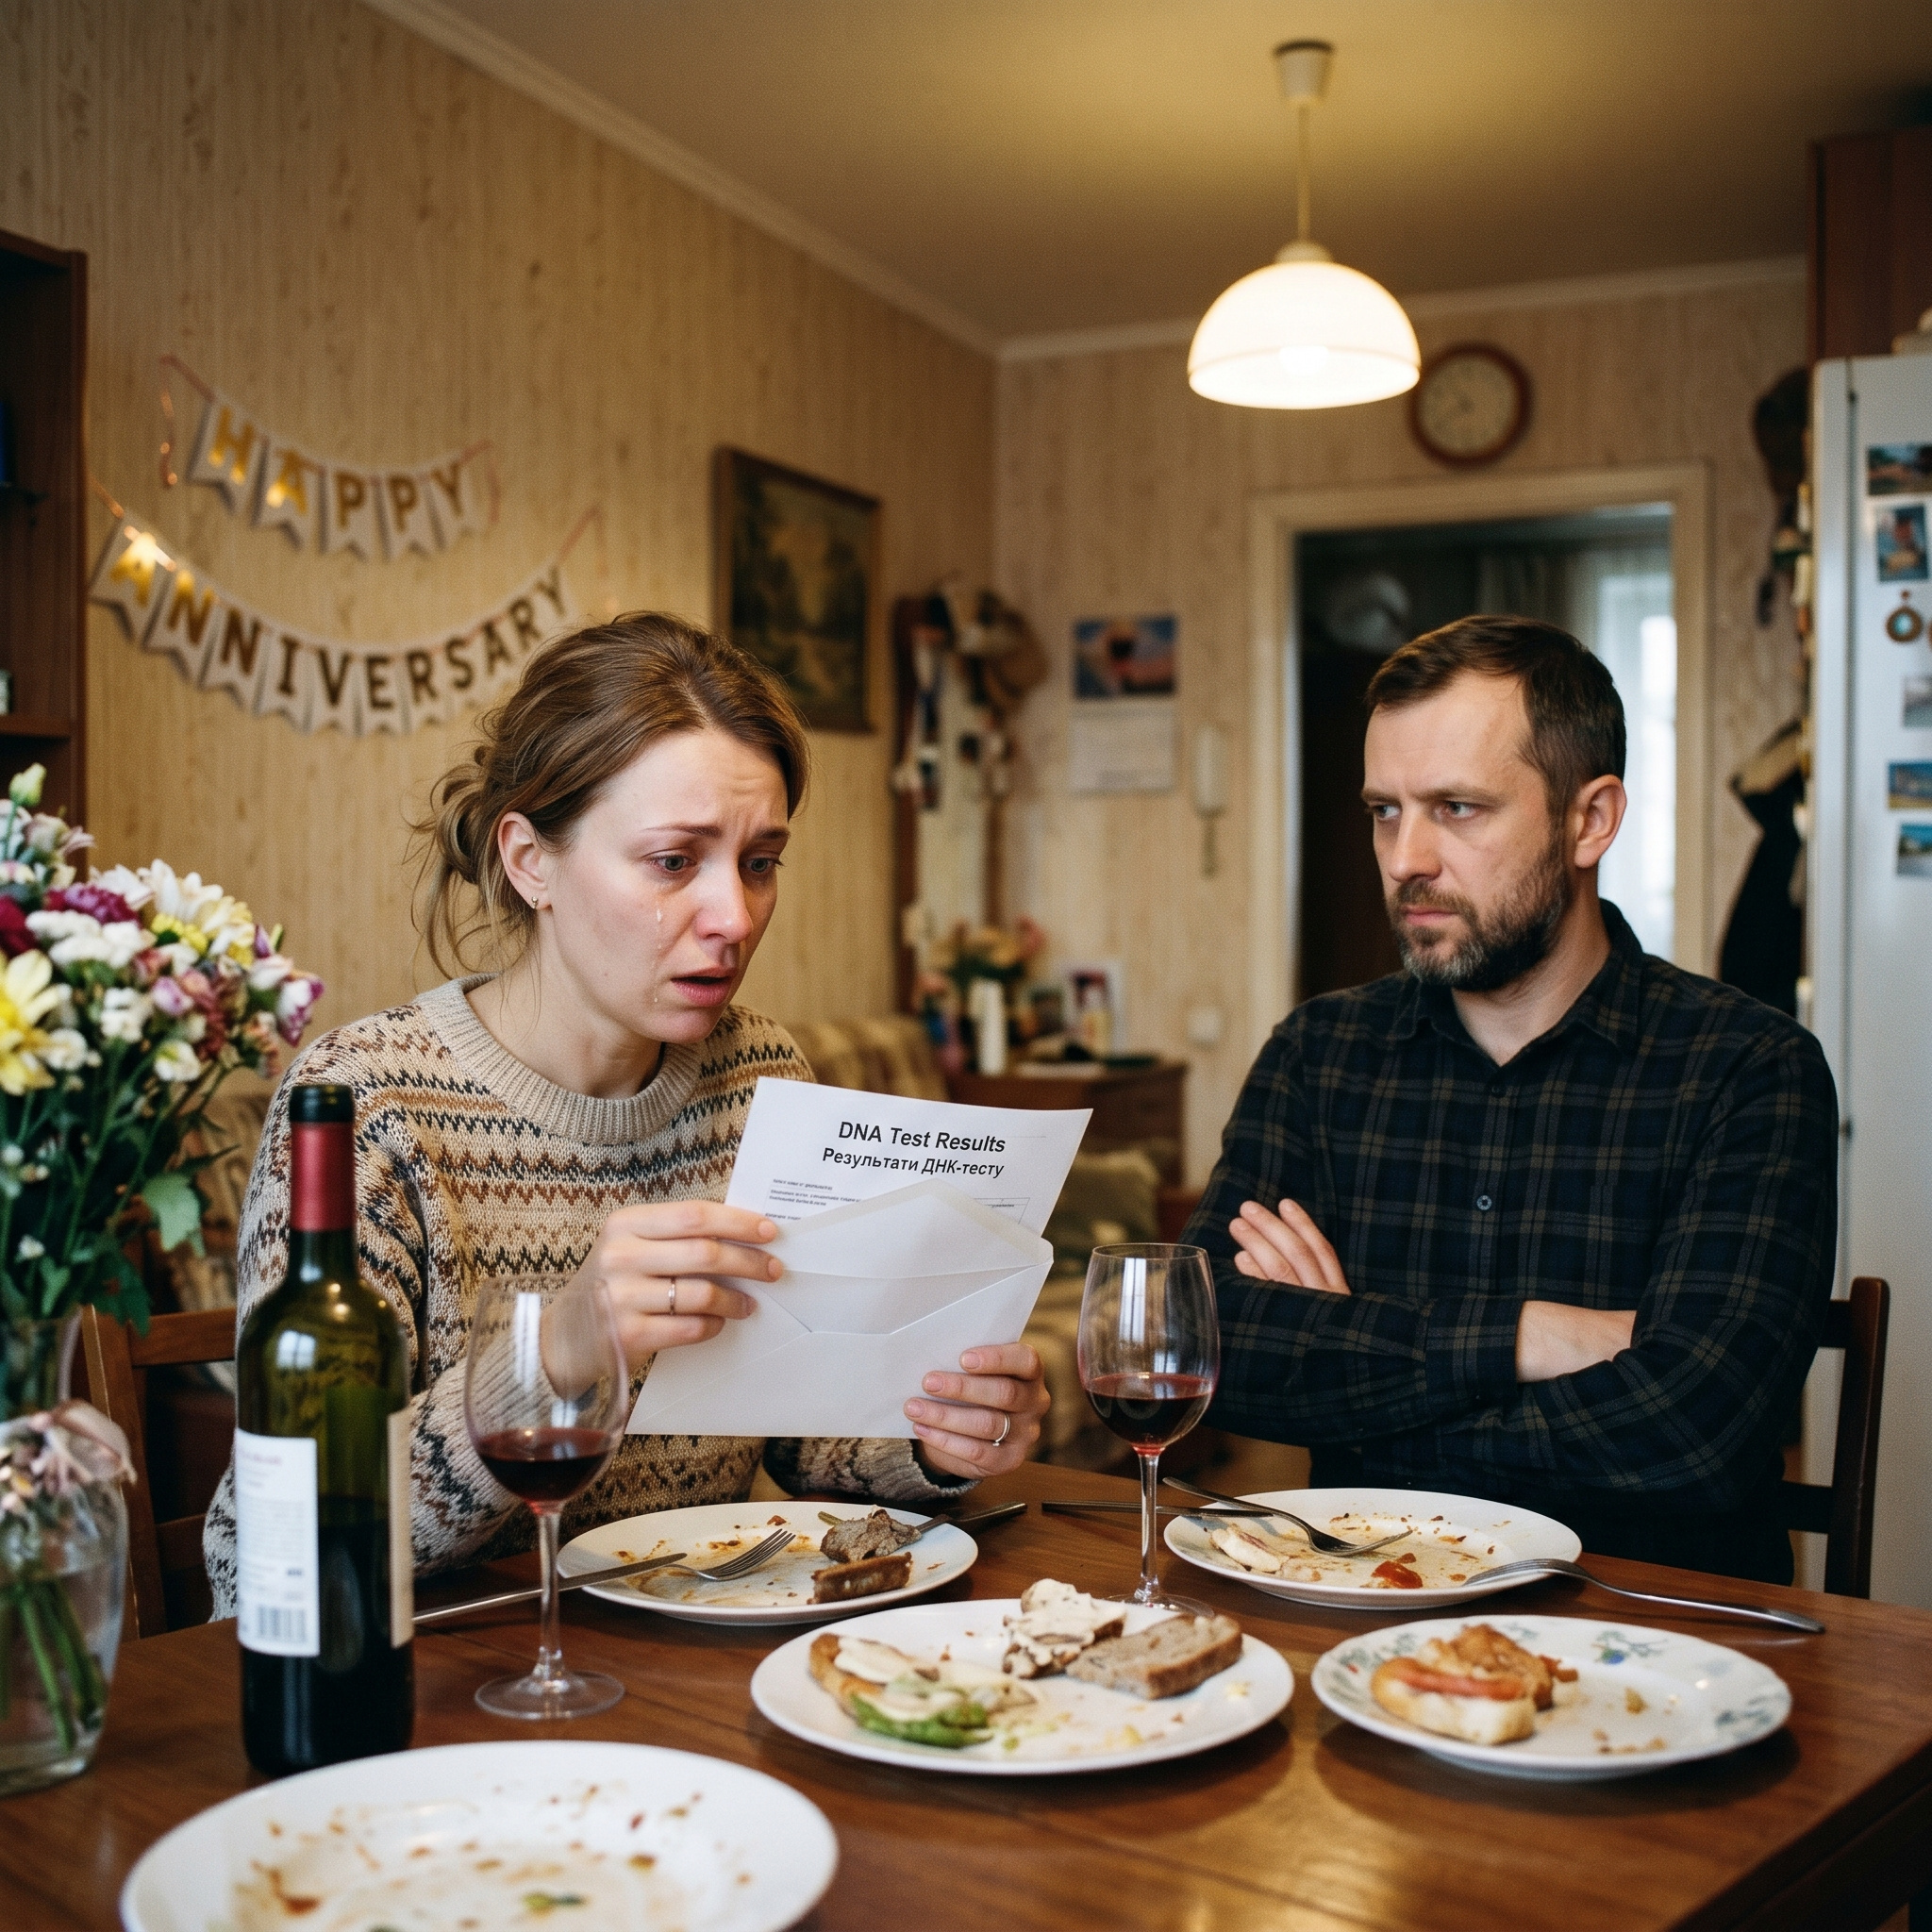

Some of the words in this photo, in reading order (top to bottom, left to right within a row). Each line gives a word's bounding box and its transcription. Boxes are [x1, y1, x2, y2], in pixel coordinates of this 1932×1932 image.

[208, 407, 464, 534] HAPPY
[108, 533, 568, 711] ANNIVERSARY
[823, 1147, 919, 1172] Результати
[921, 1158, 1005, 1179] ДНК-тесту
[839, 1121, 882, 1143] DNA
[891, 1126, 930, 1148] Test
[936, 1132, 1006, 1153] Results
